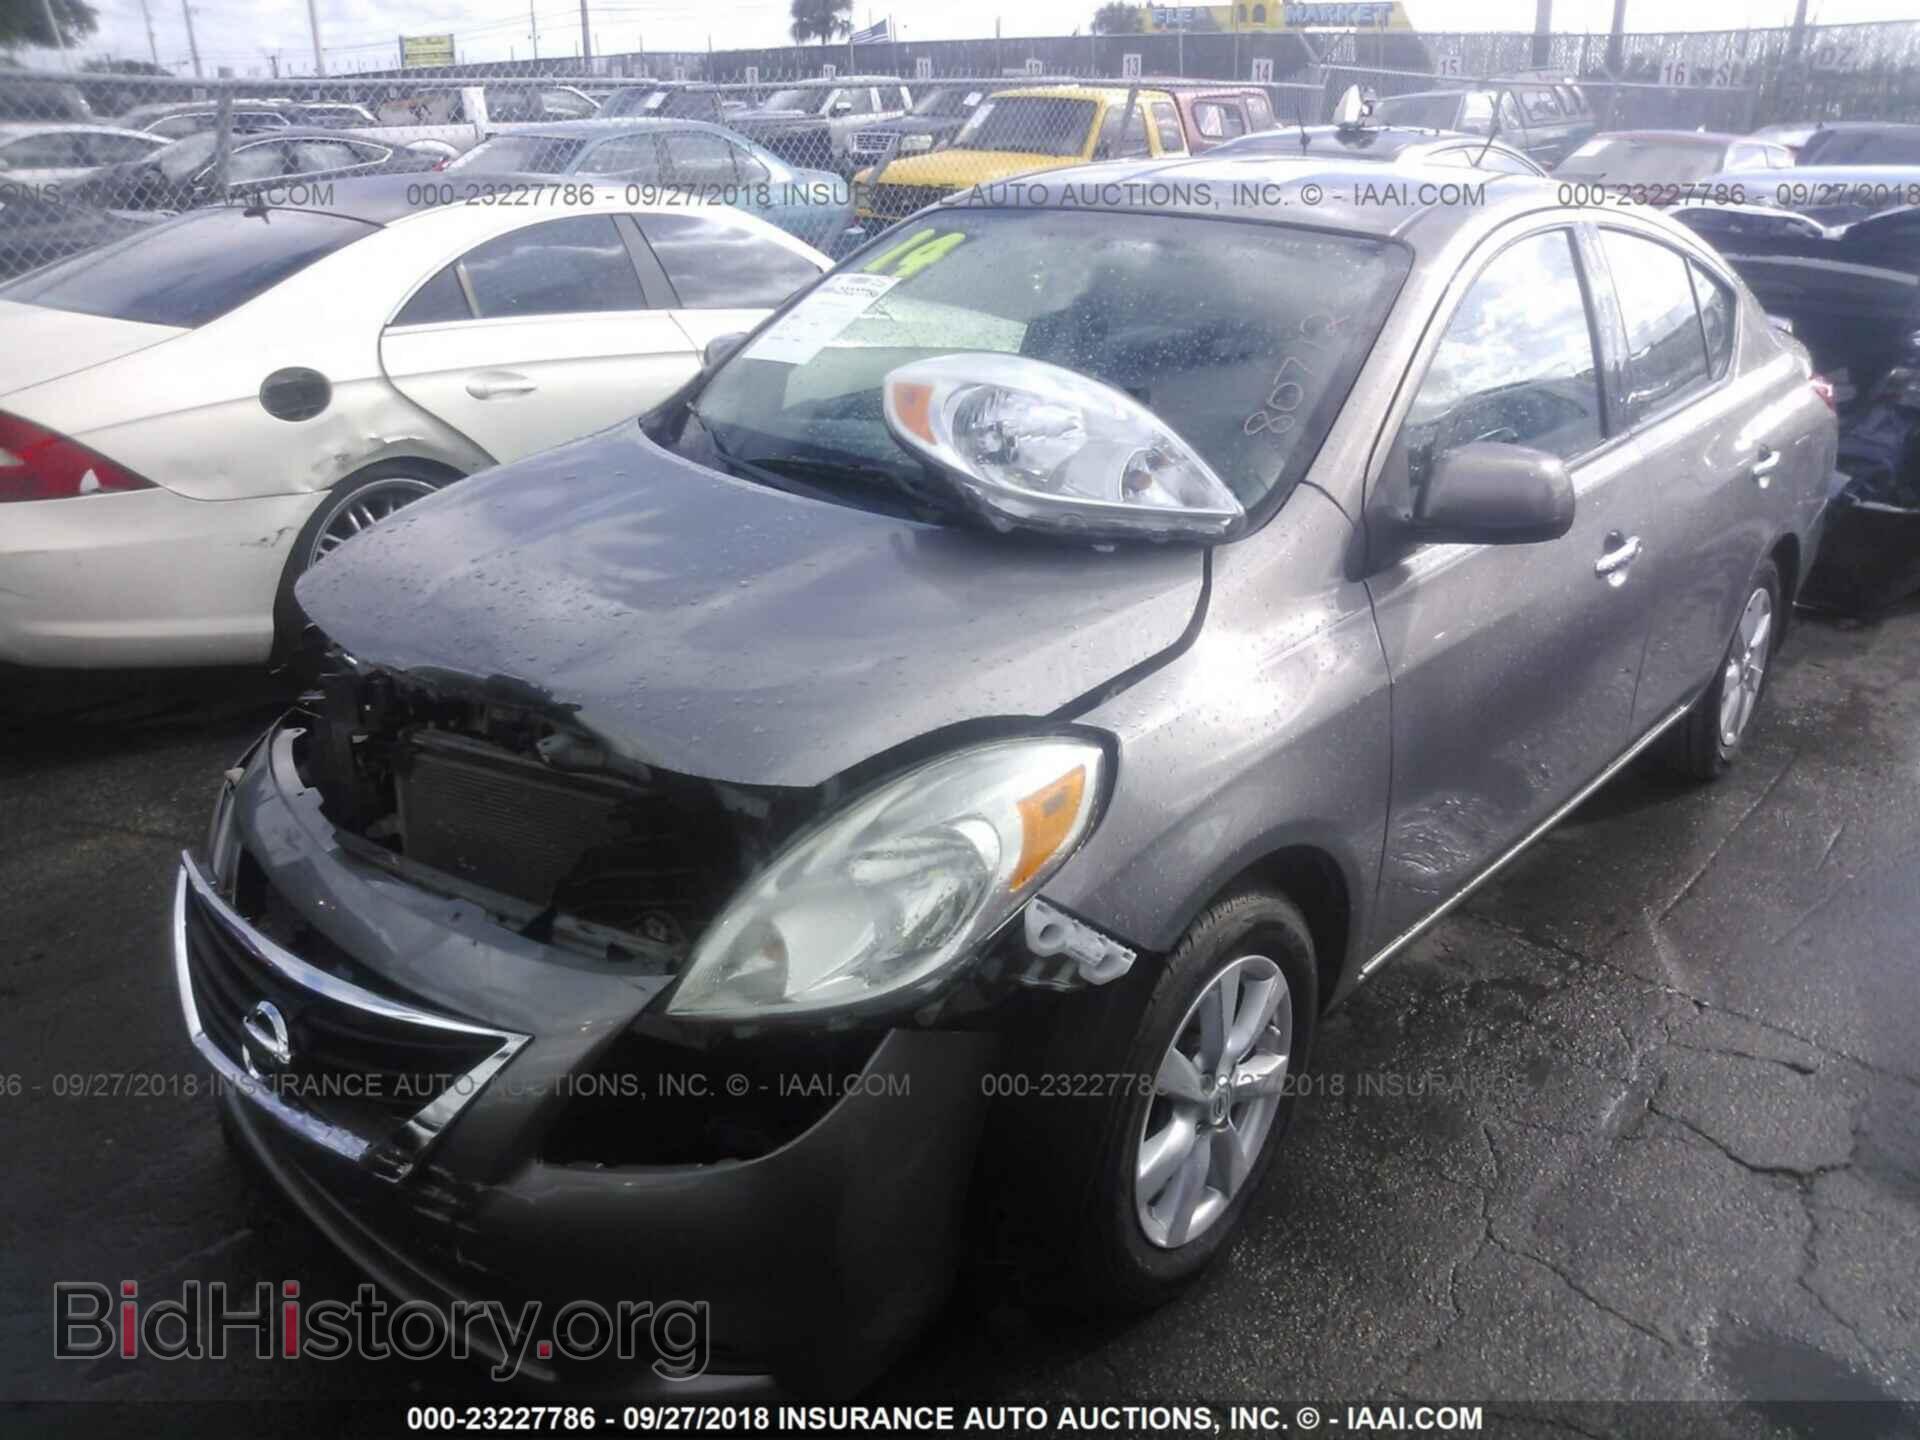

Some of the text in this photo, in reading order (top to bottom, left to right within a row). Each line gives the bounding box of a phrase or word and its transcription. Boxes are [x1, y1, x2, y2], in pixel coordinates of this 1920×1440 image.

[1285, 3, 1393, 26] MARKET
[1126, 55, 1139, 77] 13
[1255, 62, 1269, 82] 14
[1441, 59, 1457, 76] 15
[1664, 61, 1685, 85] 16
